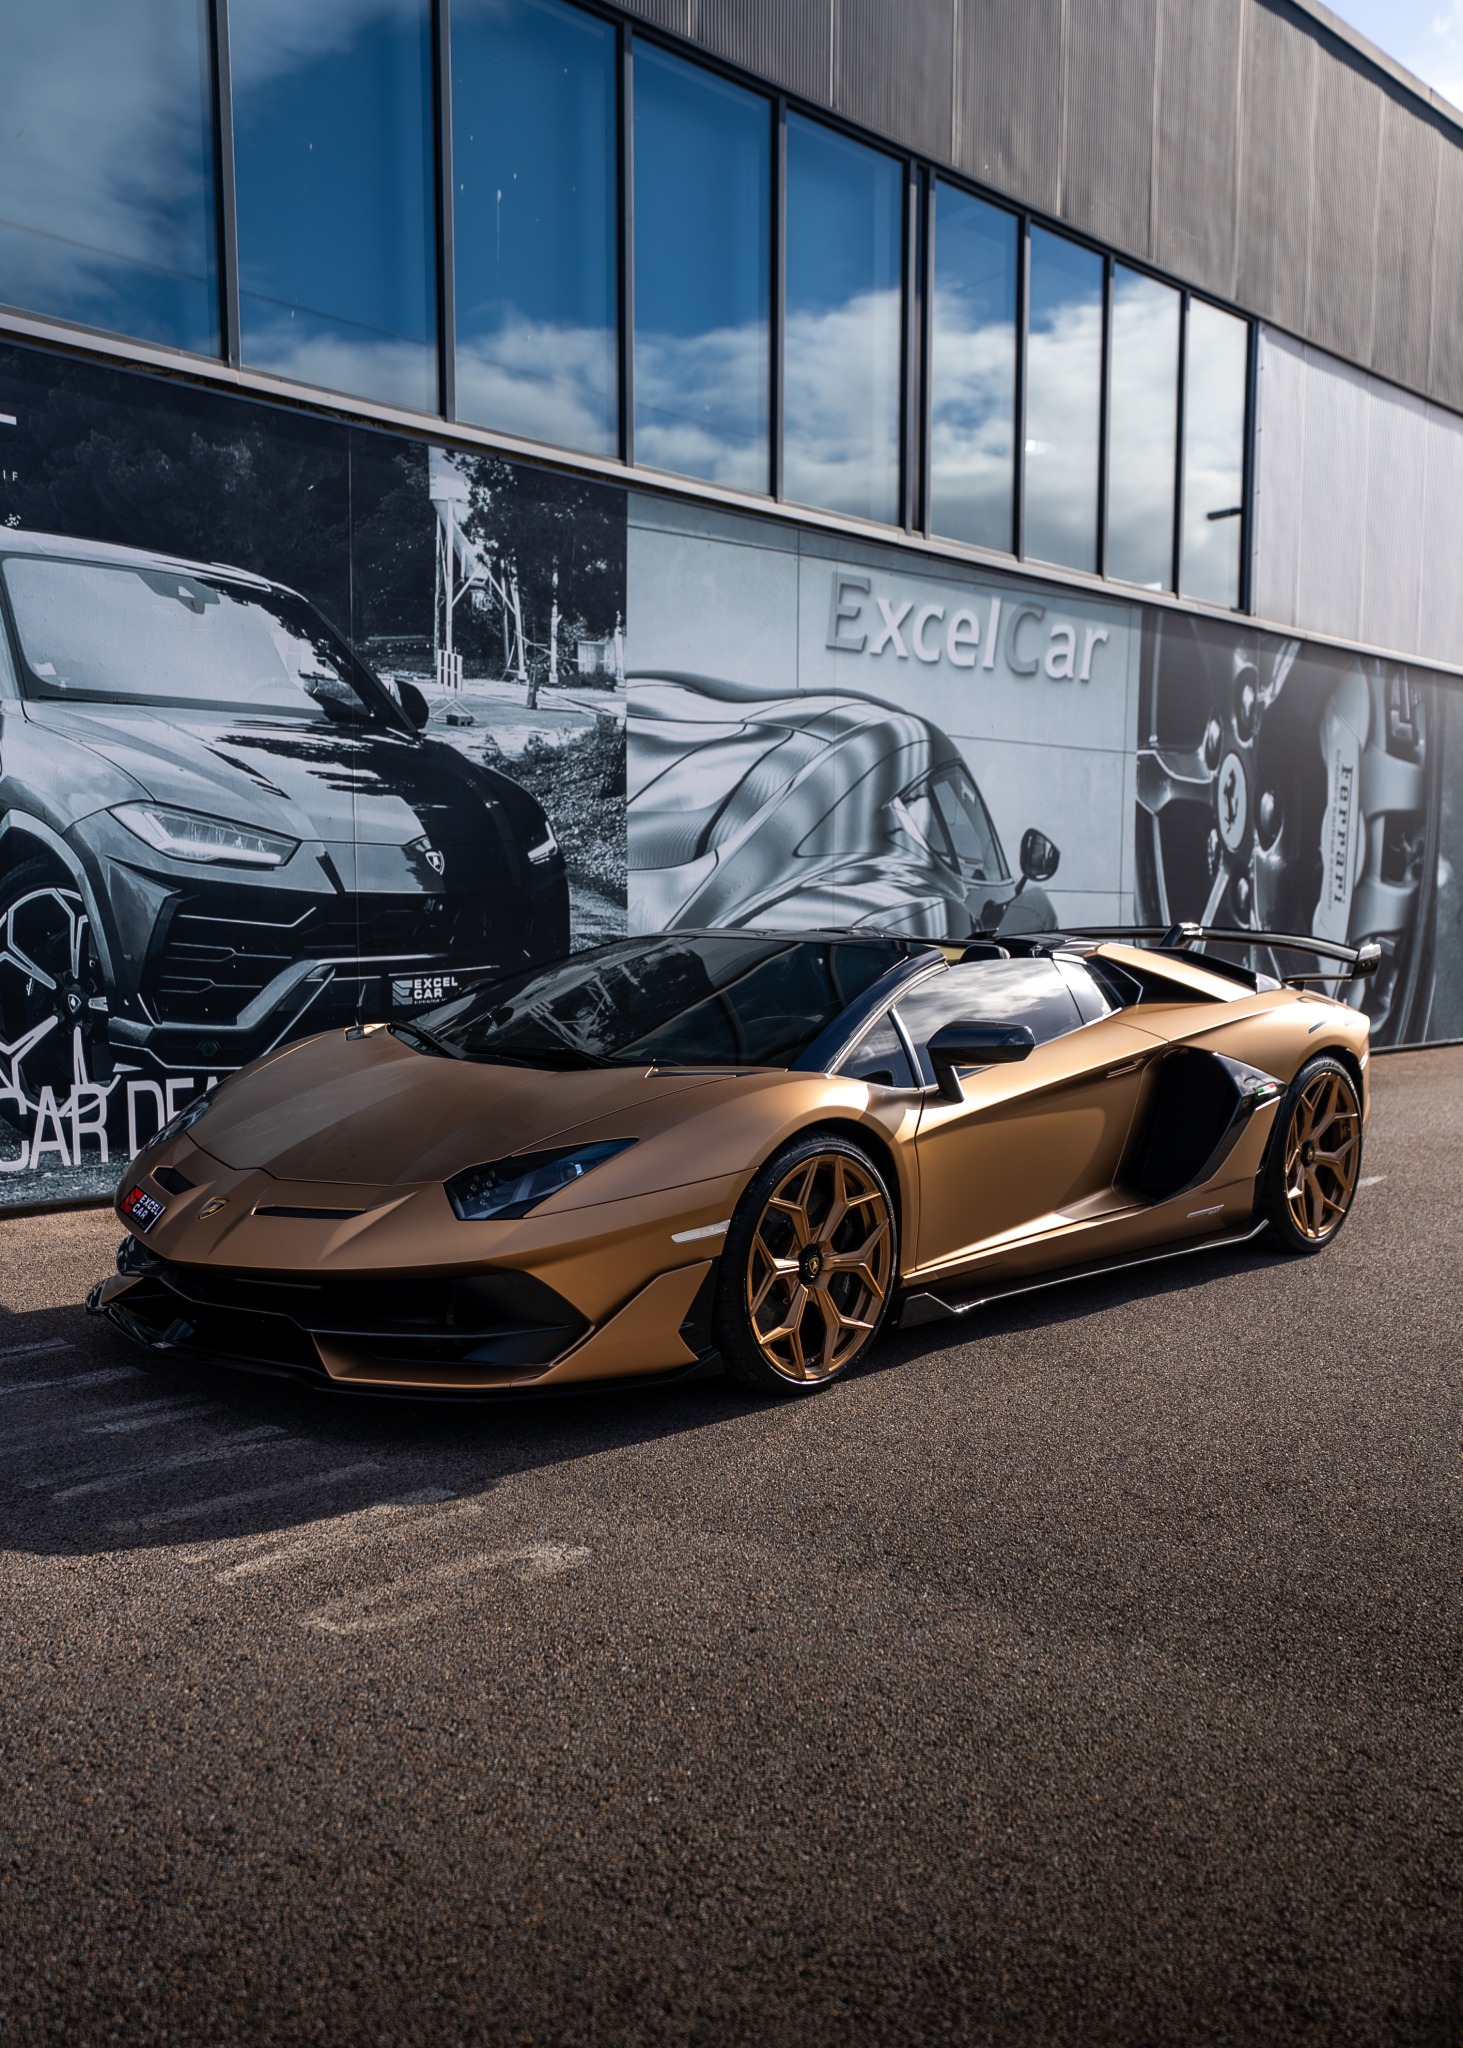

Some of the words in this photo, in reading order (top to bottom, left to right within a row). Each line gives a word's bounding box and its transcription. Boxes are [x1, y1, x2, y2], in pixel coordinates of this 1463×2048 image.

[825, 572, 1109, 682] ExcelCar
[1334, 763, 1353, 904] Ferrari
[414, 976, 458, 989] EXCEL
[414, 988, 442, 1000] CAR
[0, 1083, 109, 1172] CAR
[127, 1076, 220, 1161] DE
[132, 1203, 149, 1220] CAR
[139, 1194, 161, 1216] EXCEL
